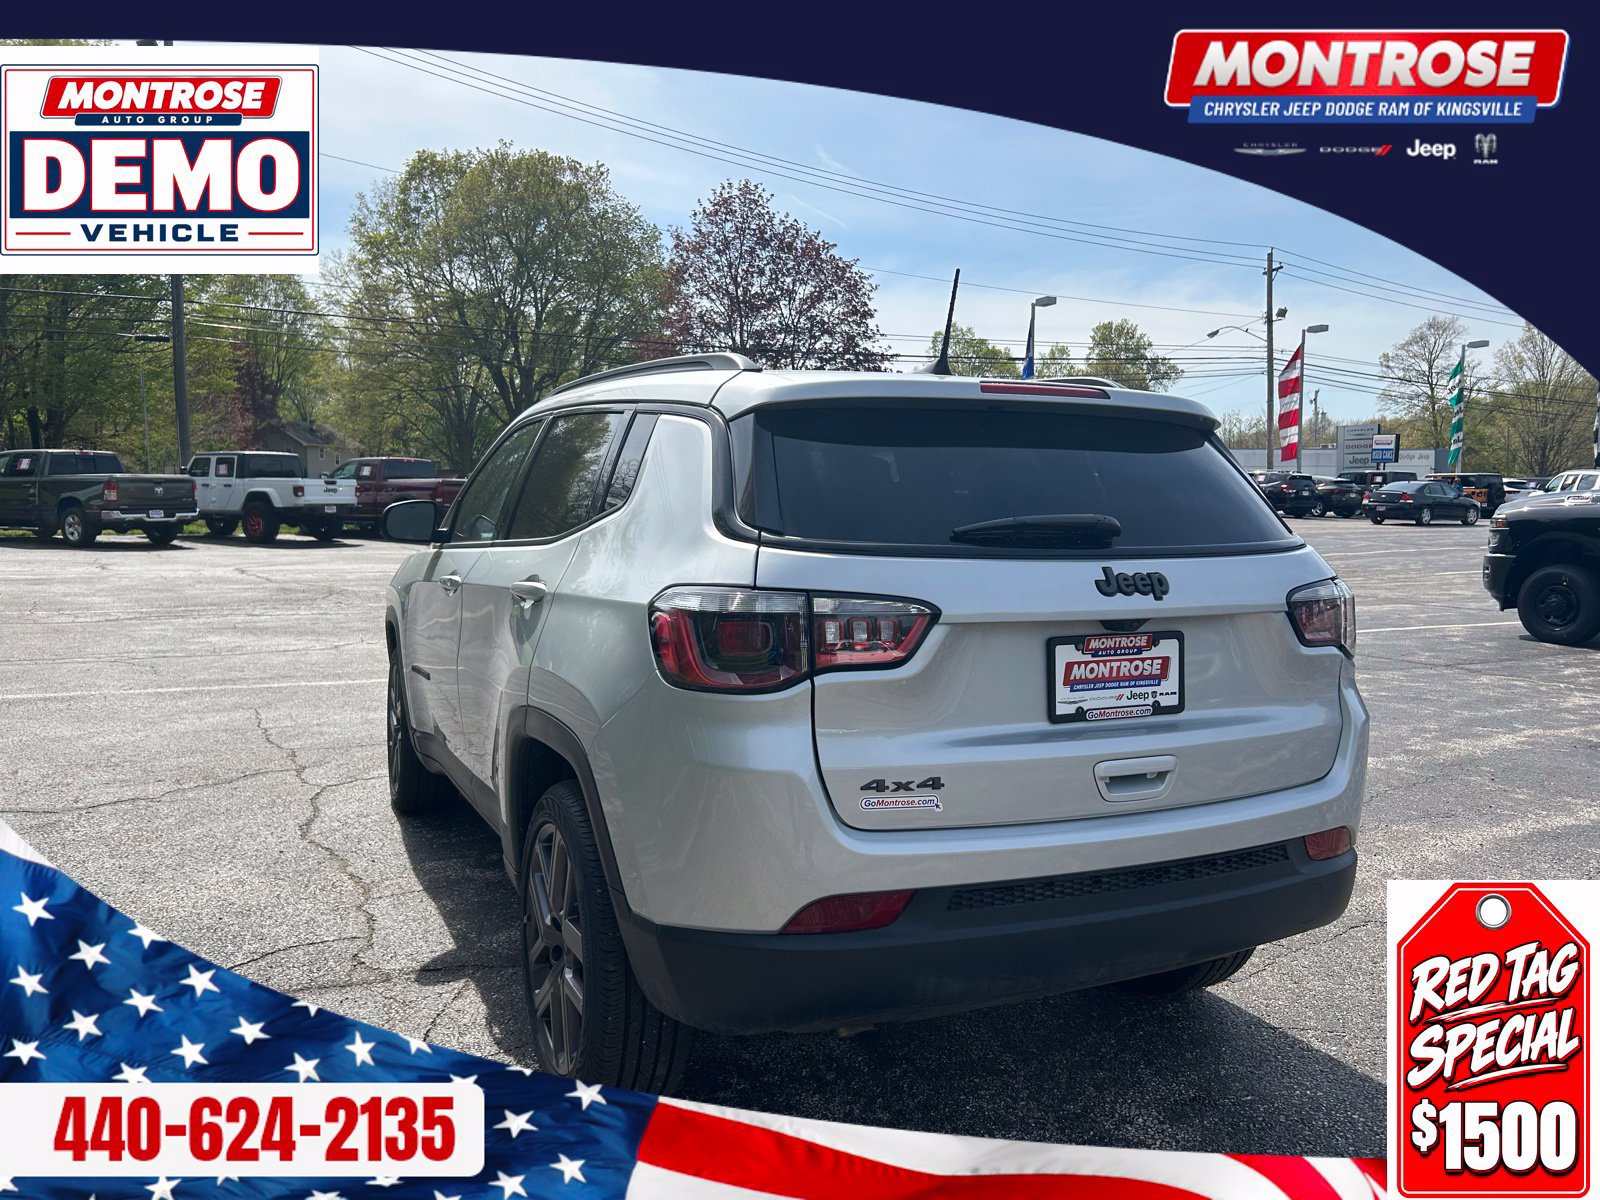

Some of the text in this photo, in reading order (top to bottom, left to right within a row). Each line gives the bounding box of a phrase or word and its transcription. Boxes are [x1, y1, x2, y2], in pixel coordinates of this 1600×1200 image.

[1349, 456, 1369, 464] Jeep
[1094, 566, 1170, 601] Jeep
[1088, 636, 1148, 649] MONTROSE
[1070, 659, 1162, 680] MONTROSE
[1126, 690, 1150, 701] Jeep
[1087, 708, 1151, 719] GoMontrose.com
[860, 776, 945, 793] 4x4
[864, 798, 935, 808] GoMontrose.com
